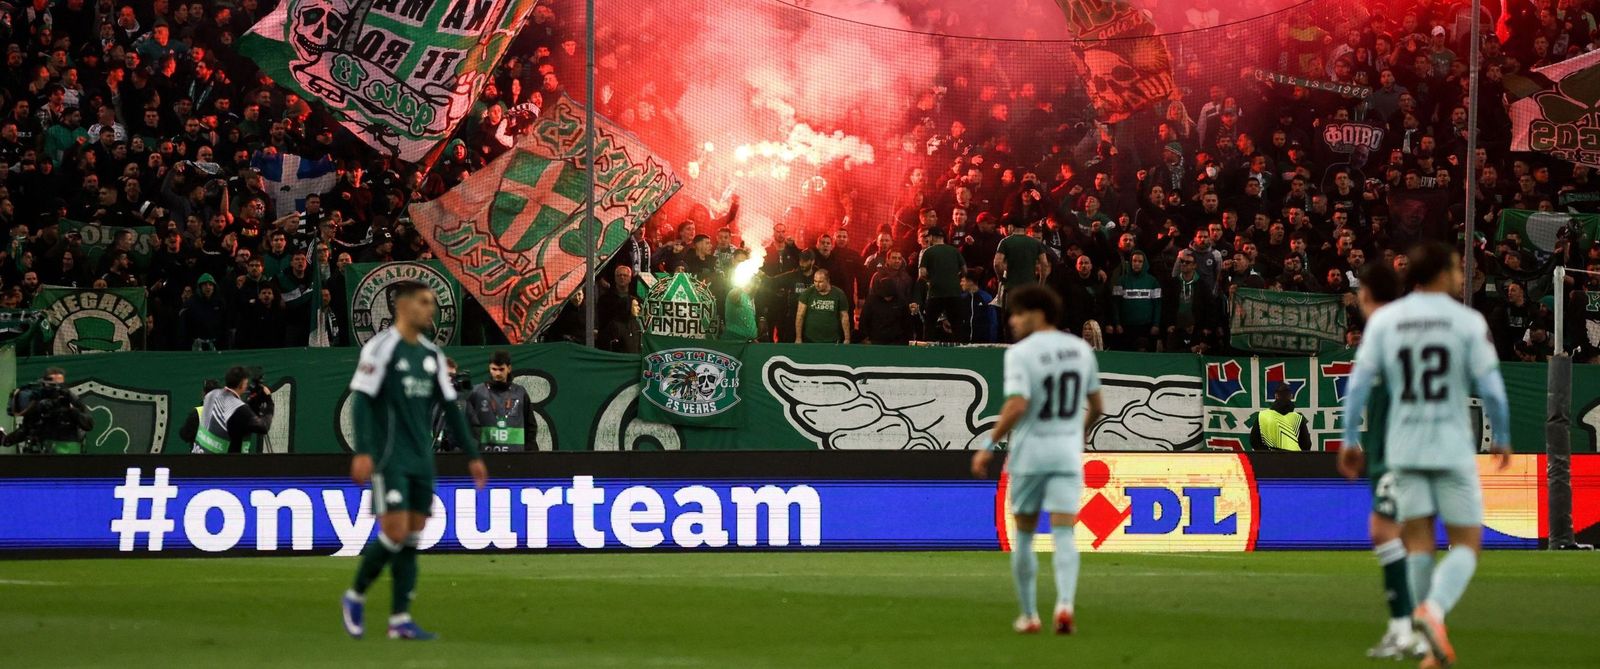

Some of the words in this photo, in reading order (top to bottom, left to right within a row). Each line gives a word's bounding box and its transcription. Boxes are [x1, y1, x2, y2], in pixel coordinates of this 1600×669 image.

[48, 292, 142, 335] MEGARA
[648, 301, 713, 318] GREEN
[640, 316, 719, 335] VANDALS
[1397, 344, 1450, 403] 12
[682, 402, 717, 416] YEARS
[1037, 371, 1081, 420] 10
